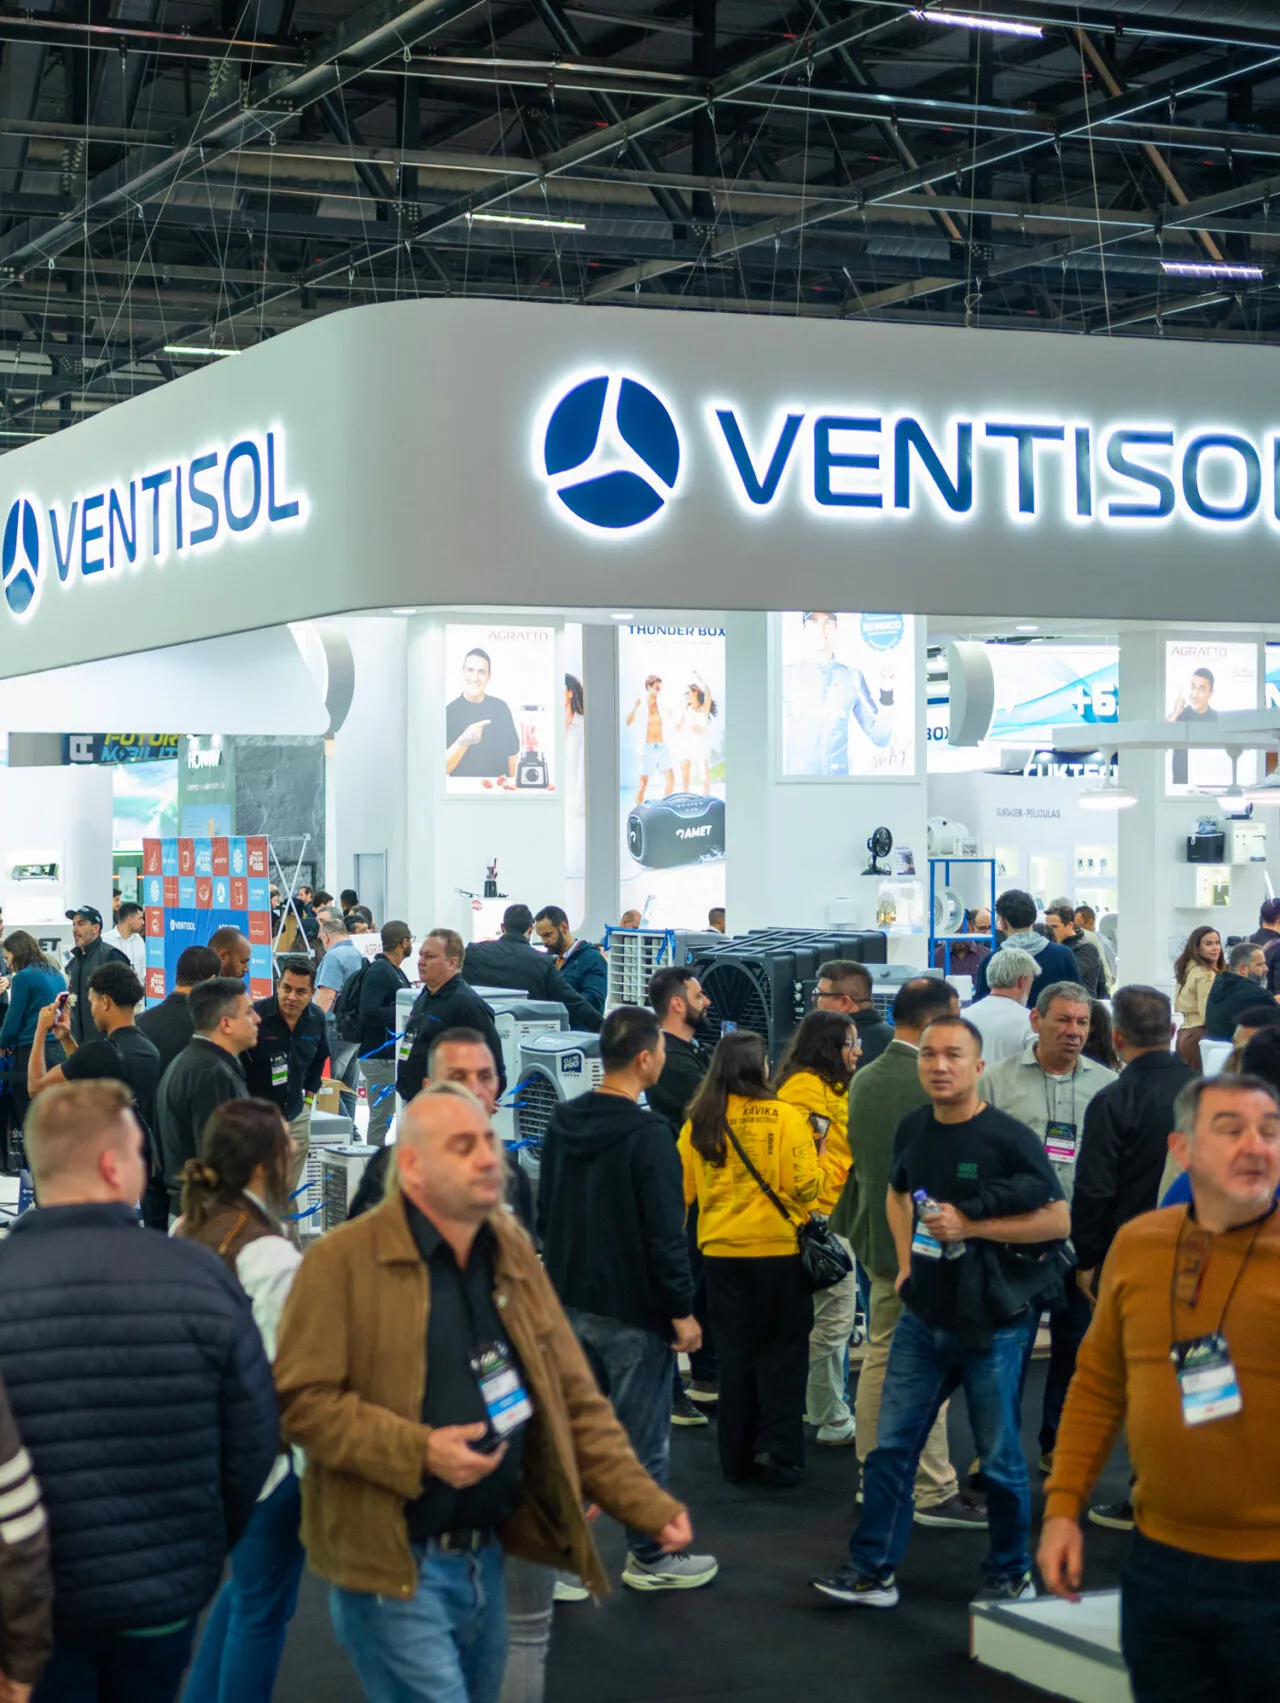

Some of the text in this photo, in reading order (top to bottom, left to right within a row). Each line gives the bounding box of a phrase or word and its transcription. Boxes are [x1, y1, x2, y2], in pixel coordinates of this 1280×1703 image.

[715, 408, 1280, 524] VENTISO
[49, 432, 299, 582] VENTISOL
[488, 630, 549, 642] AGRATTO
[628, 625, 726, 637] THUNDER BOX
[1171, 646, 1228, 657] AGRATTO
[1072, 683, 1118, 717] +6
